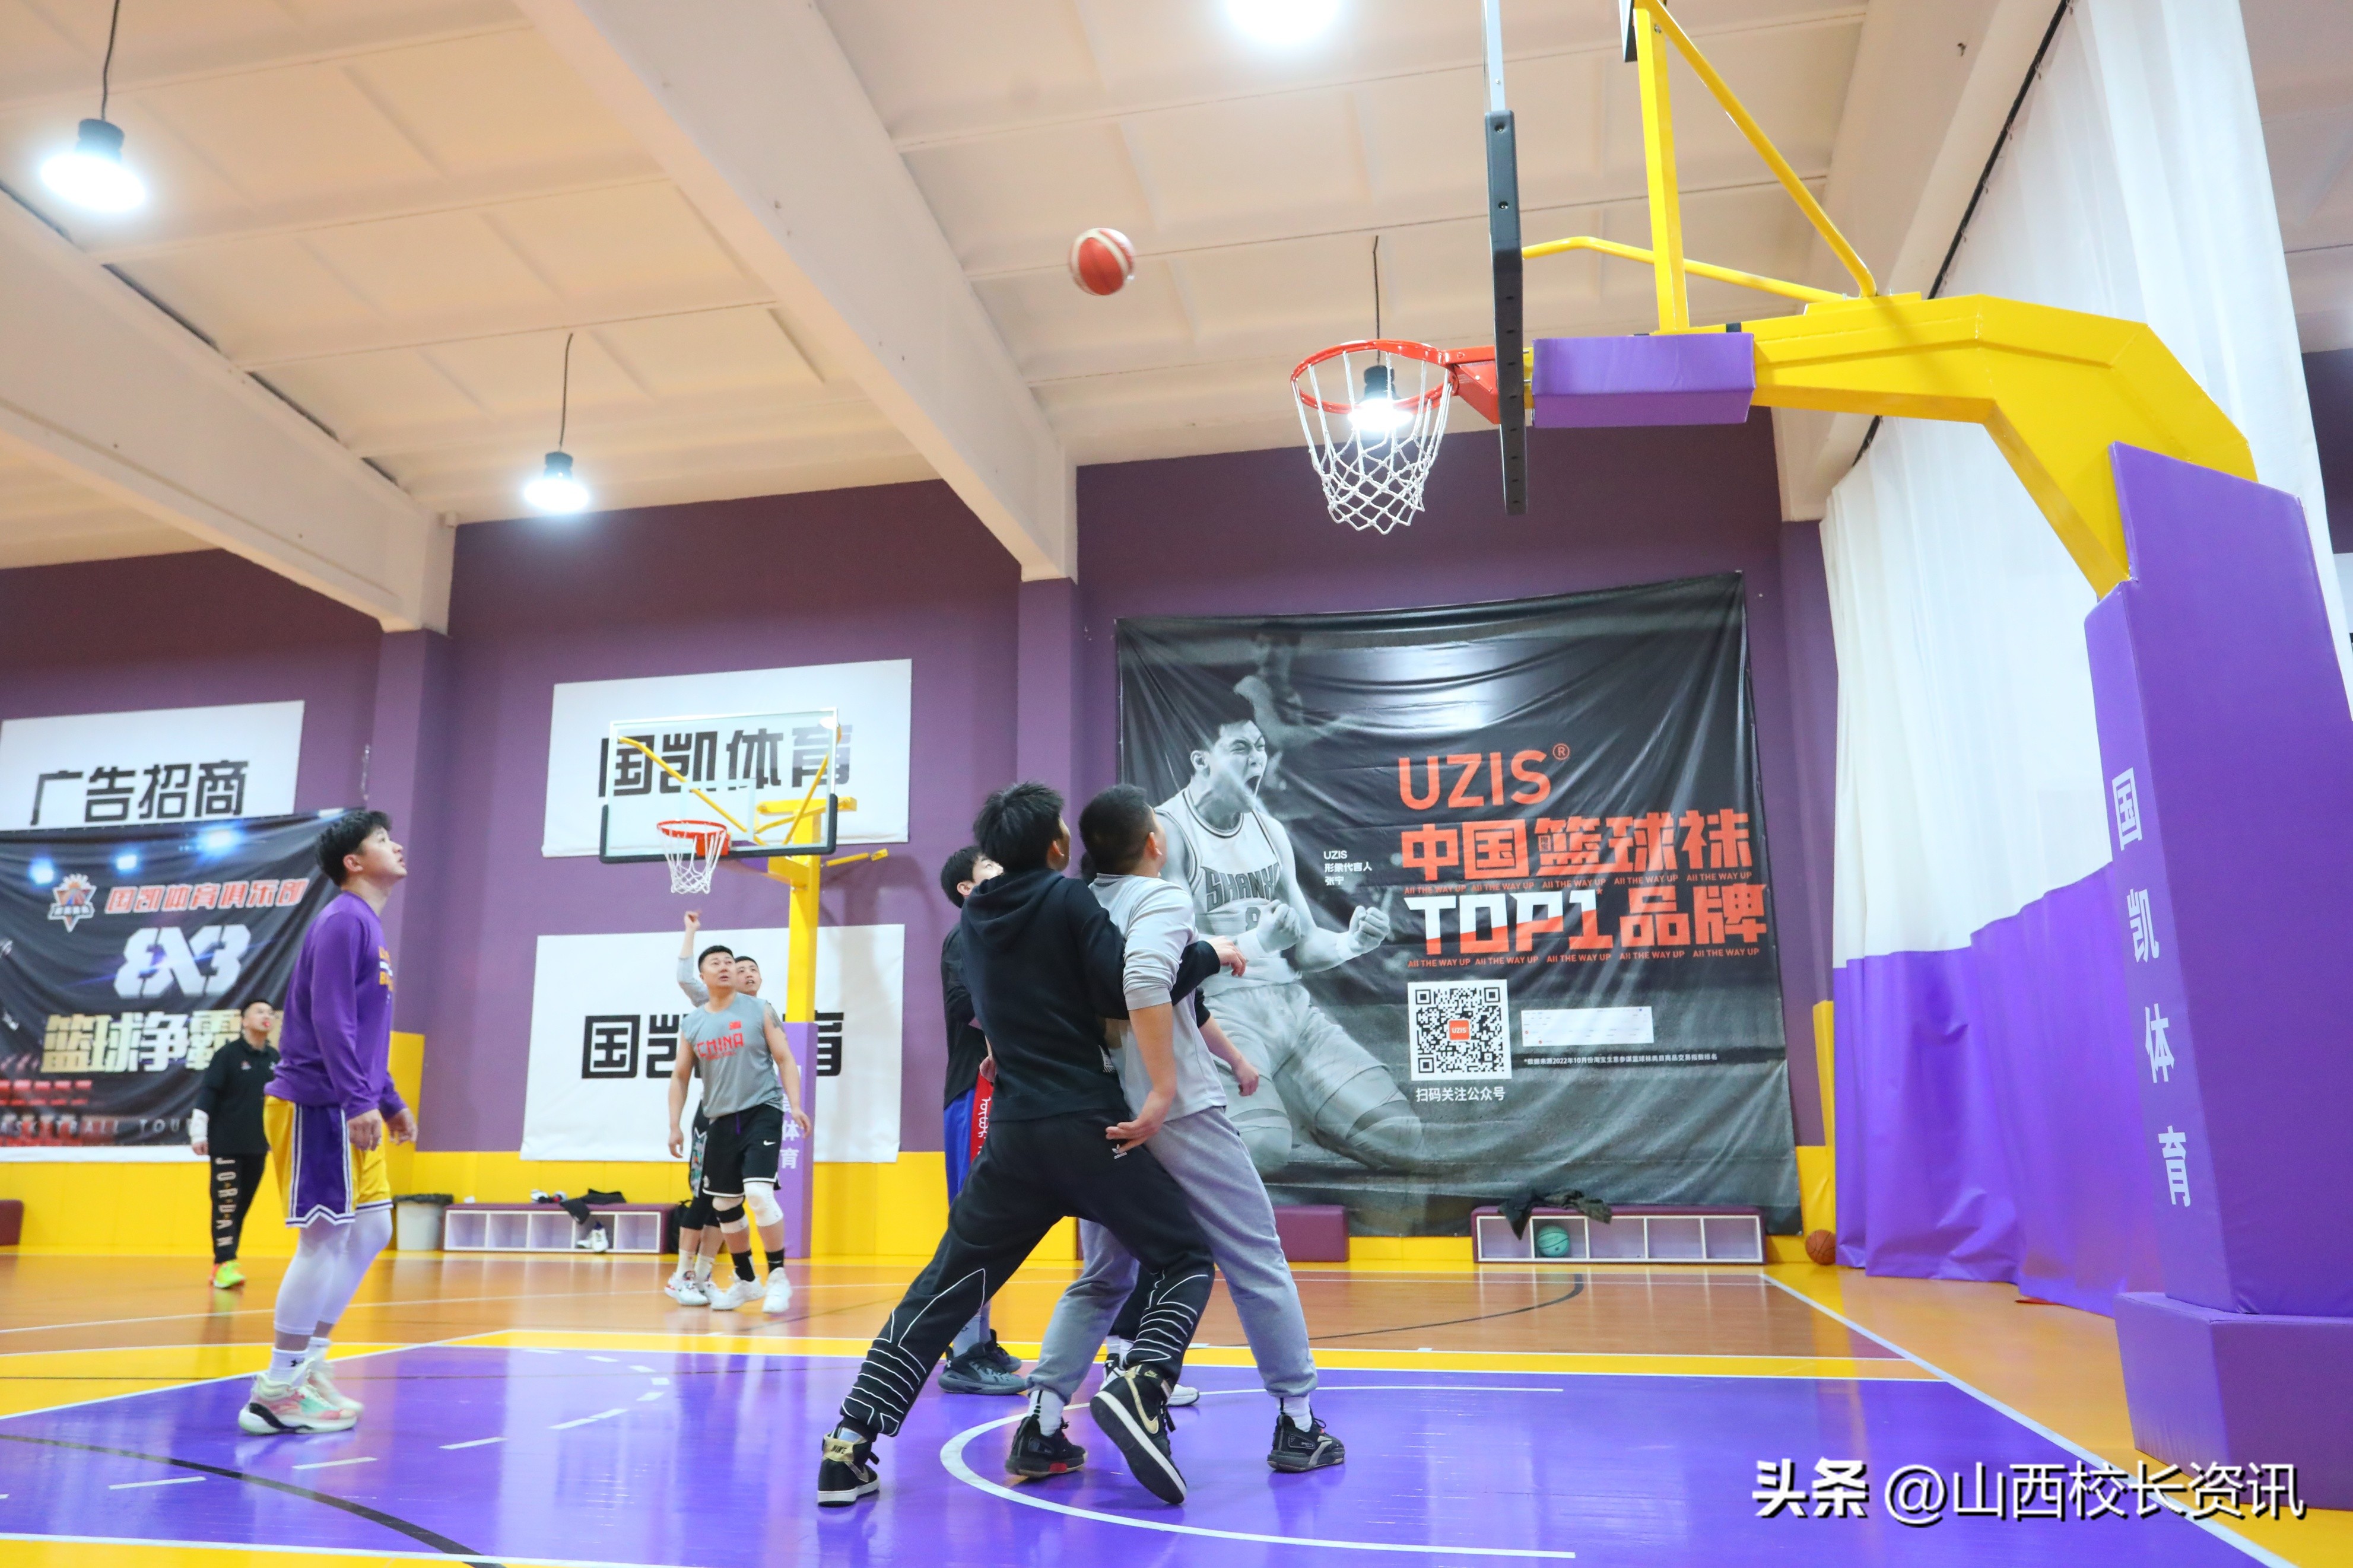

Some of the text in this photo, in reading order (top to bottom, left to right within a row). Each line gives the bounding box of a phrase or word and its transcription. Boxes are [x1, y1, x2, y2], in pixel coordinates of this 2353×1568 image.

[598, 724, 853, 798] 国凯体育
[30, 760, 249, 826] 广告招商
[1323, 850, 1348, 860] UZIS
[1325, 861, 1373, 873] 形象代言人
[1401, 808, 1752, 881] 中国篮球袜
[104, 878, 309, 914] 国凯体育俱乐部
[1325, 876, 1345, 886] 张宁
[2112, 767, 2191, 1207] 国凯体育
[40, 1009, 284, 1073] 篮球争霸
[1415, 1086, 1506, 1102] 扫码关注公众号
